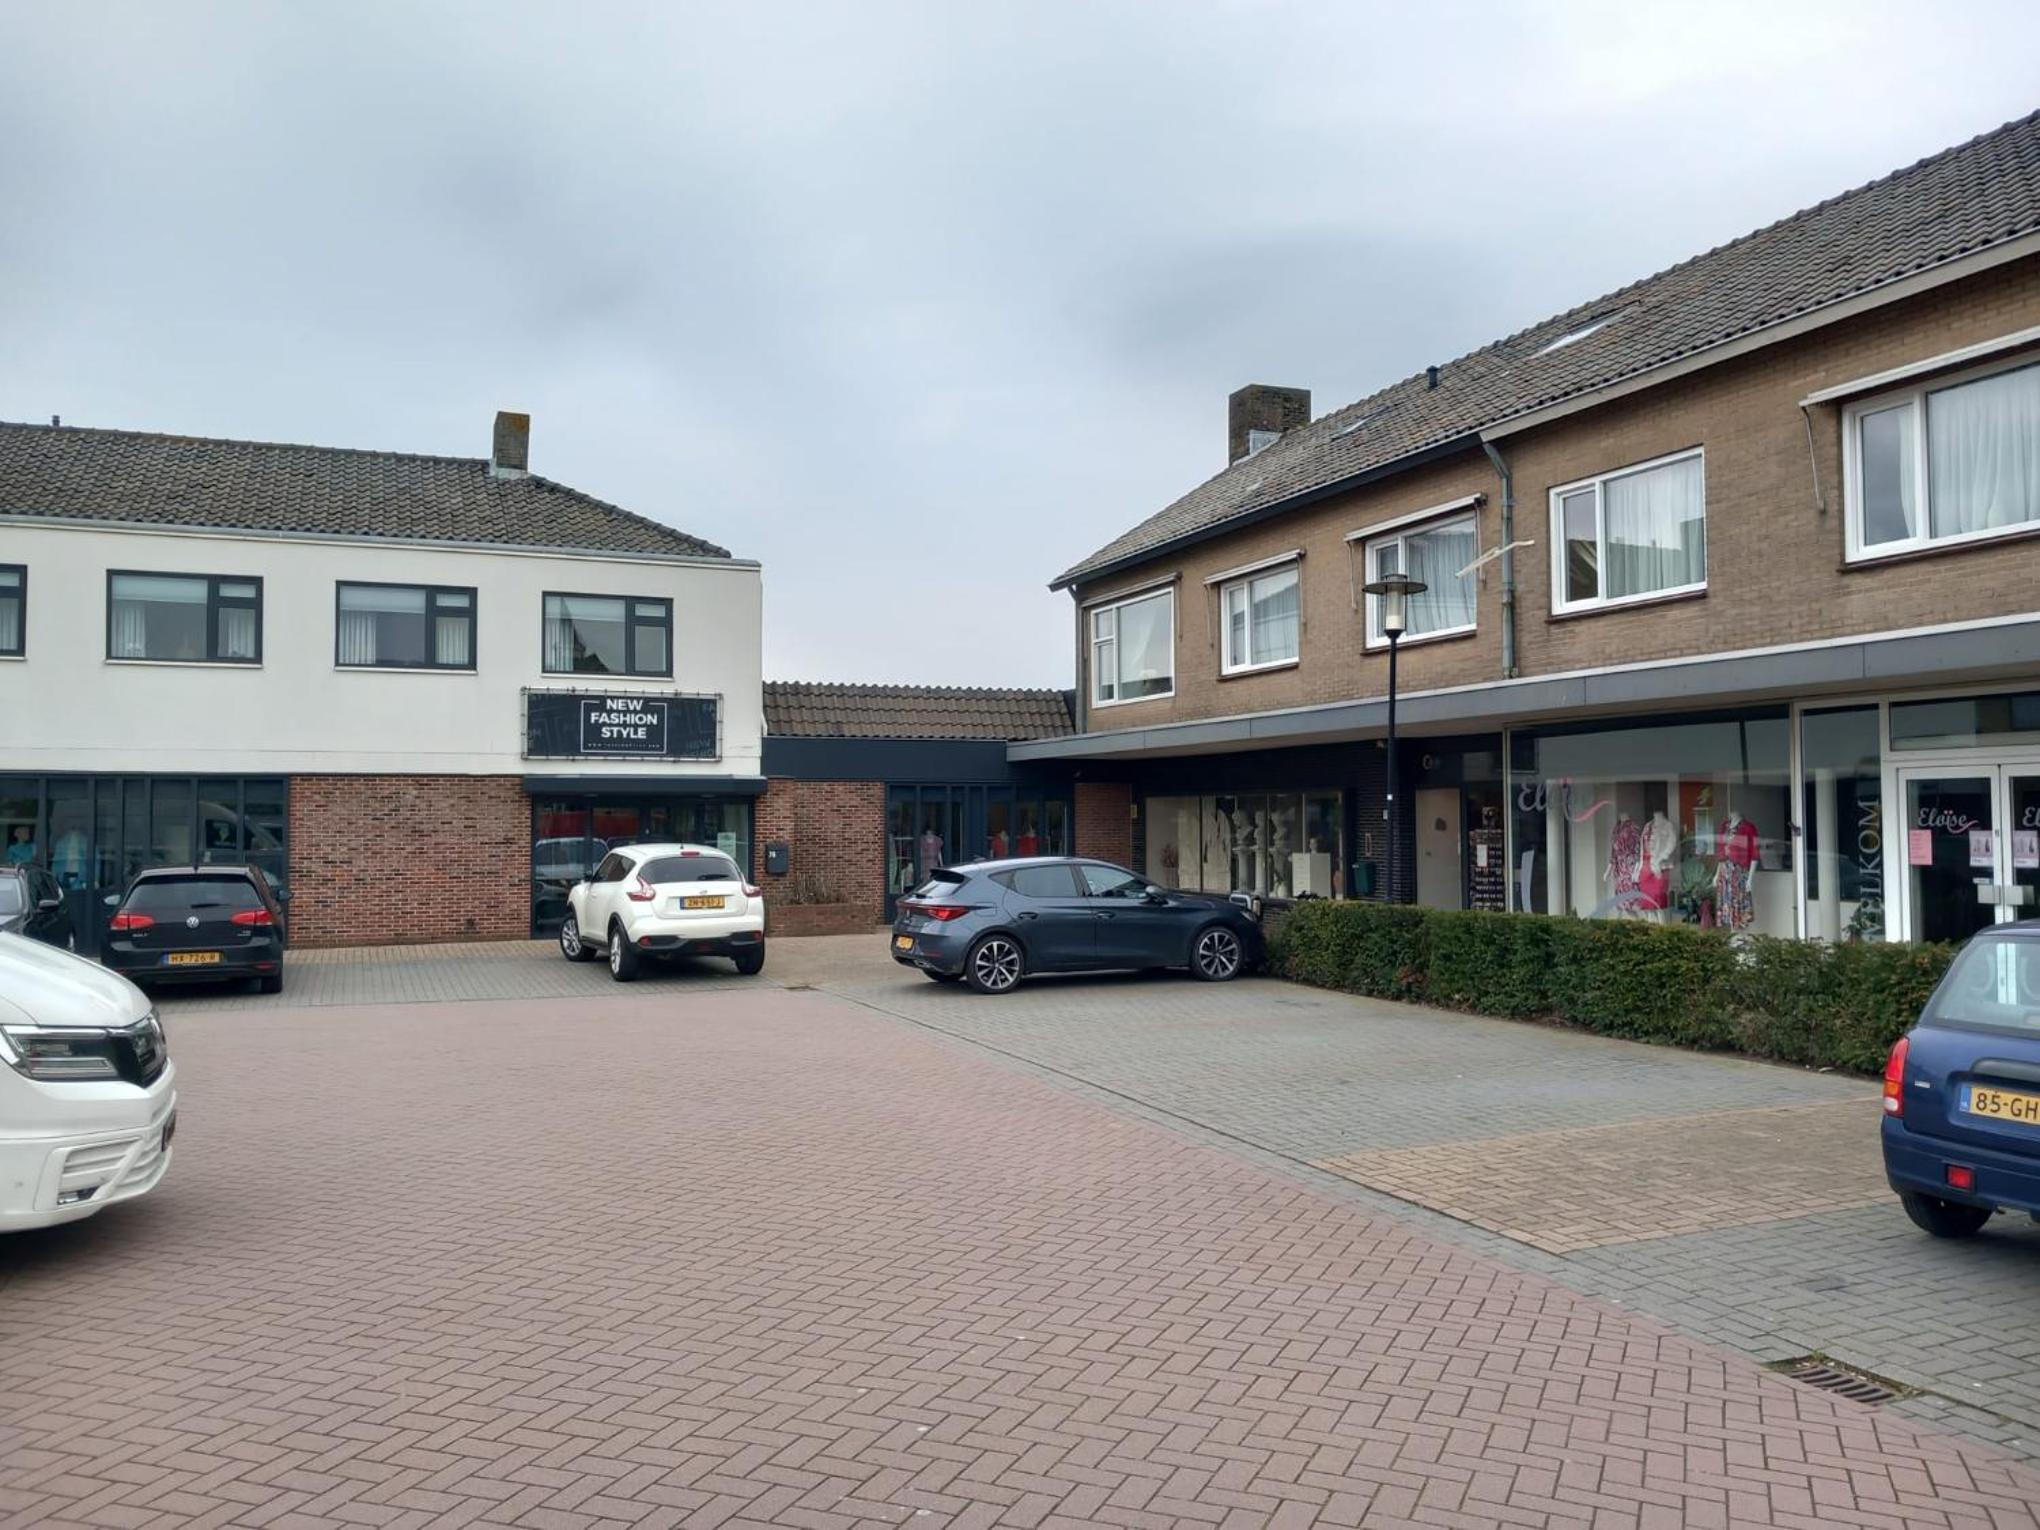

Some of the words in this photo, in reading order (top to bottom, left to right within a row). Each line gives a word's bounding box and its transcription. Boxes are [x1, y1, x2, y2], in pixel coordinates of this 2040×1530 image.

[606, 698, 643, 711] NEW
[590, 712, 658, 726] FASHION
[601, 726, 647, 739] STYLE
[1976, 1092, 2039, 1120] 85-GH
